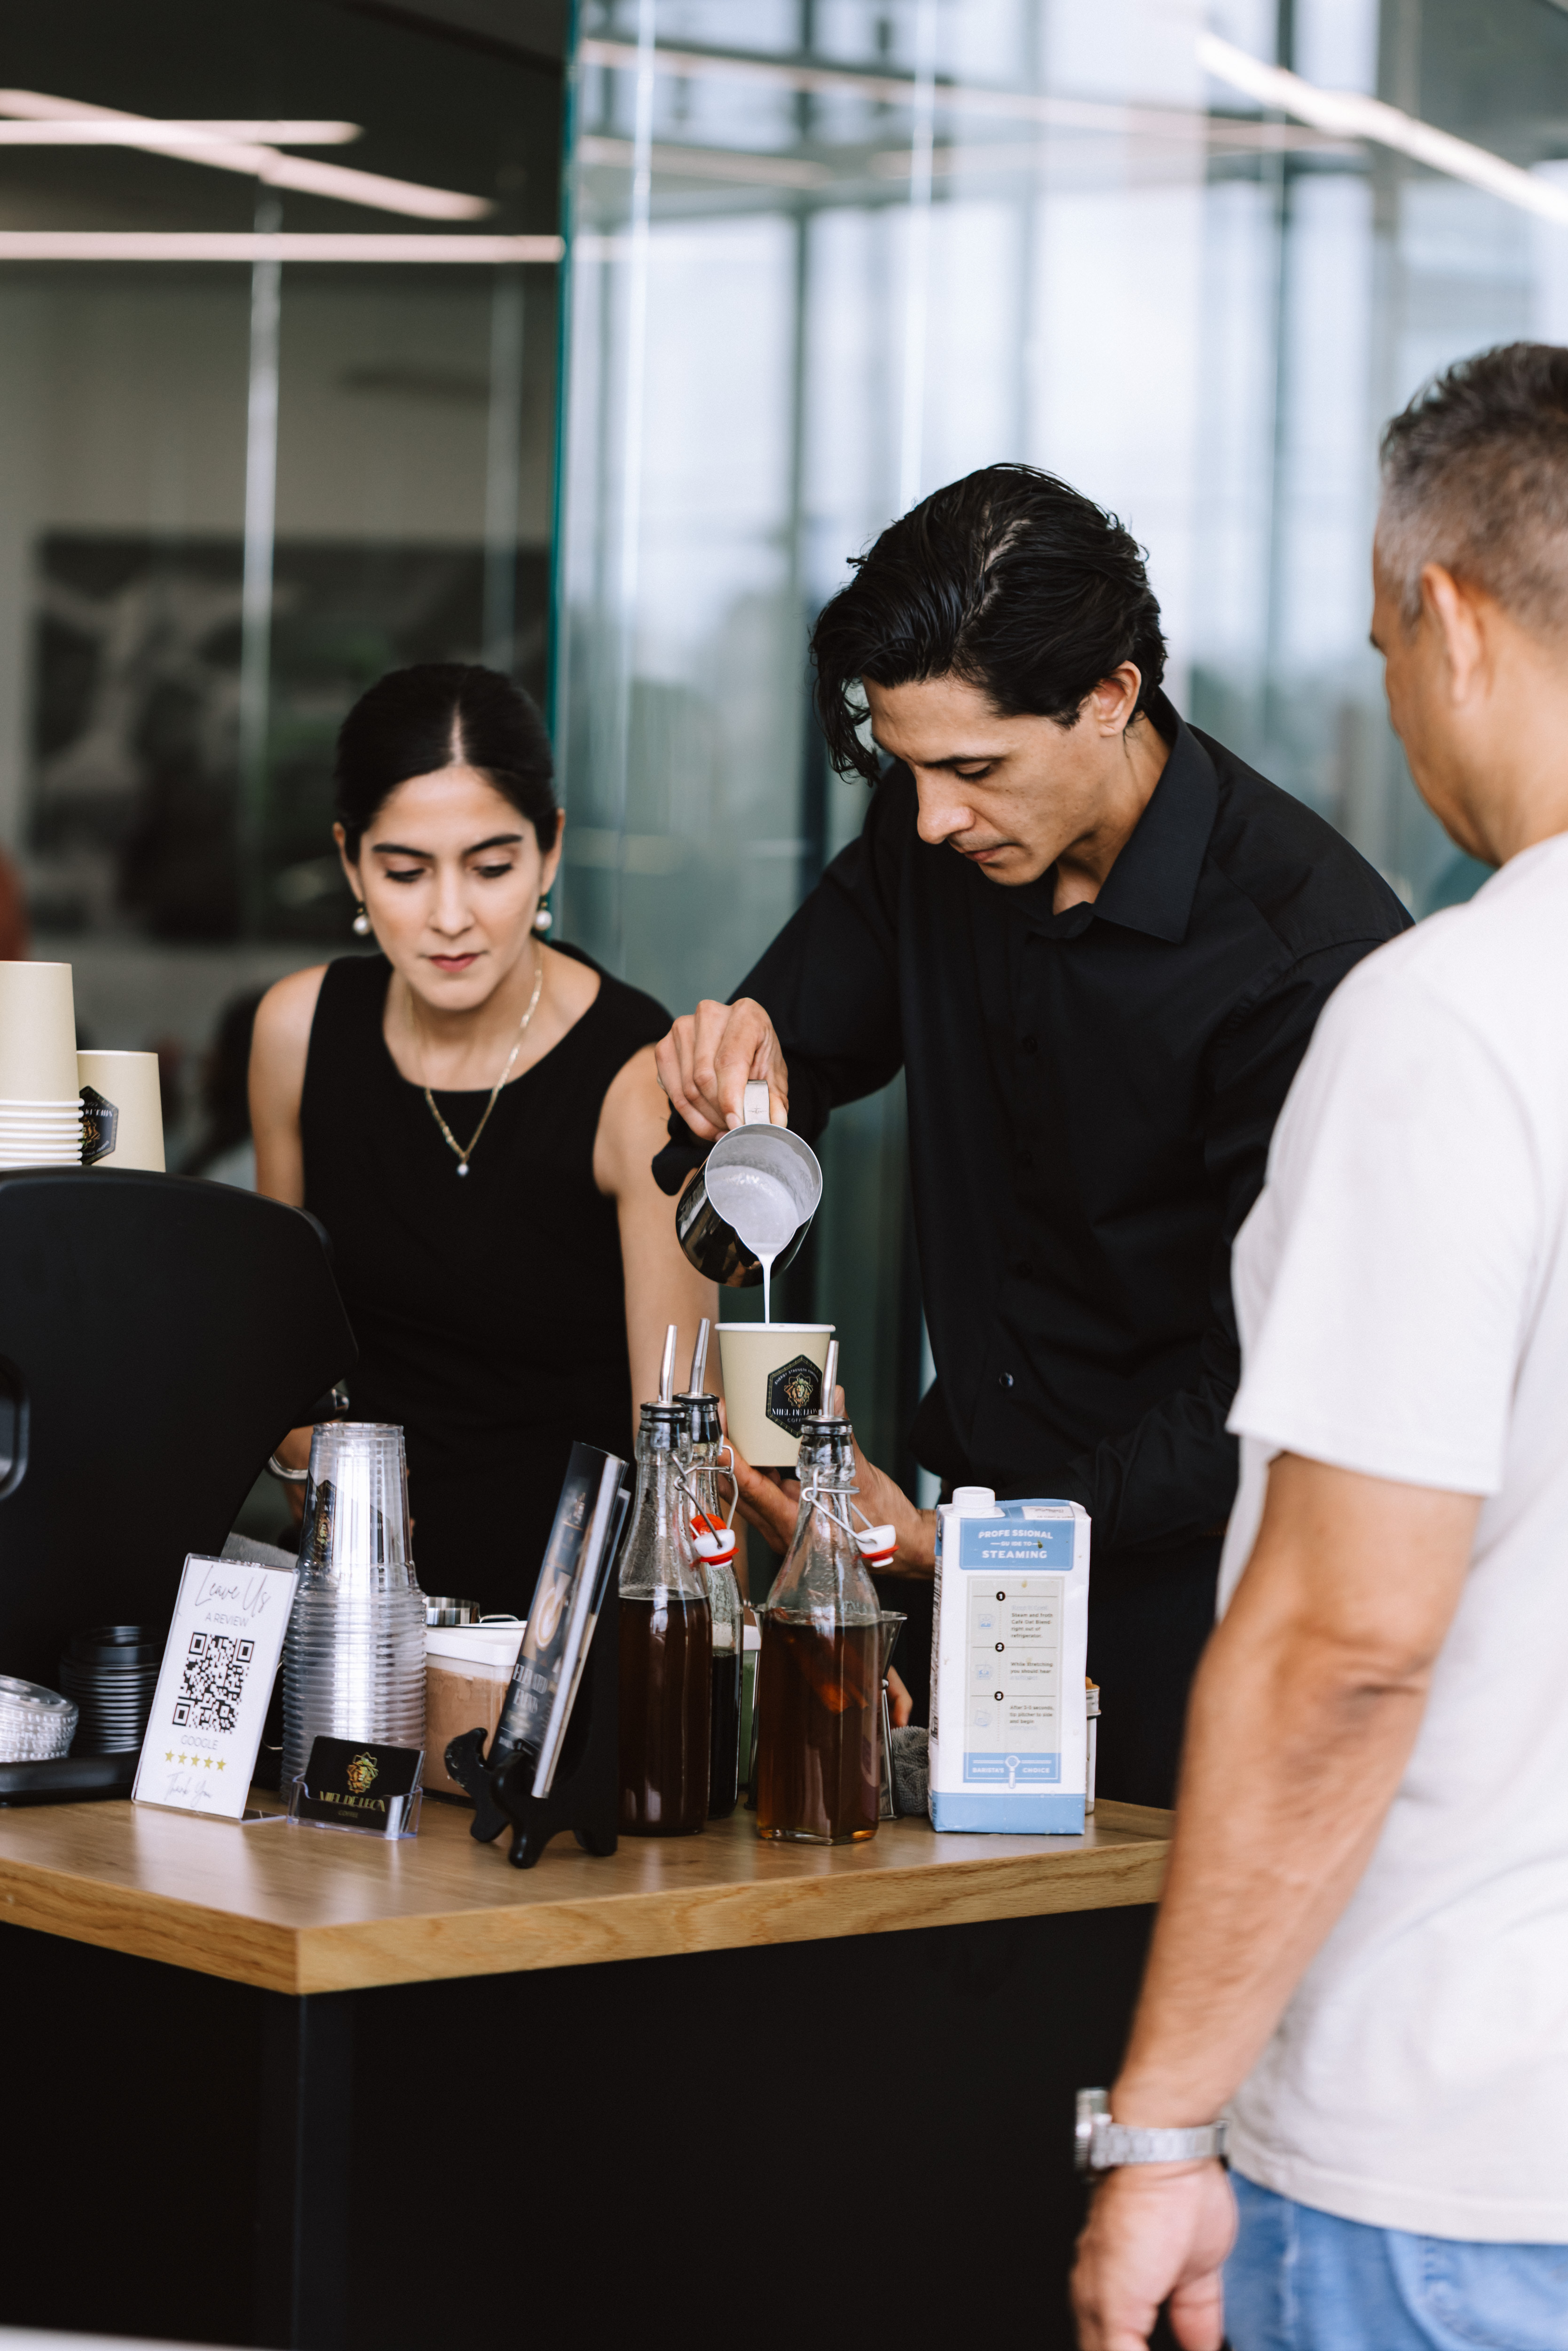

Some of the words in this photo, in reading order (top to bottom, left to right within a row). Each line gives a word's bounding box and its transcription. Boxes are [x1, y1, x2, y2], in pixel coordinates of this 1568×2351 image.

[774, 1373, 788, 1385] ENERGY
[982, 1550, 1047, 1559] STEAMING
[195, 1565, 240, 1606] Leave
[243, 1574, 272, 1617] Us
[205, 1612, 212, 1622] A
[214, 1613, 249, 1627] REVIEW
[181, 1735, 219, 1750] GOOGLE
